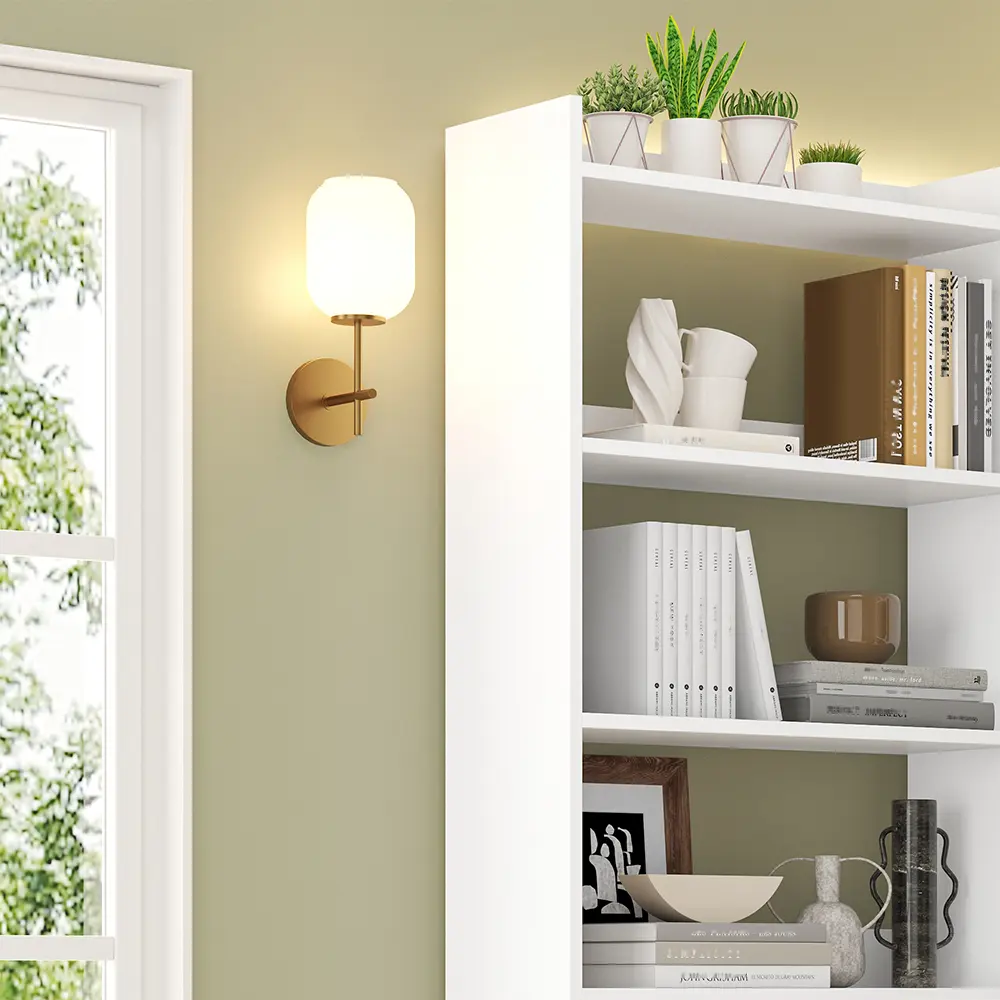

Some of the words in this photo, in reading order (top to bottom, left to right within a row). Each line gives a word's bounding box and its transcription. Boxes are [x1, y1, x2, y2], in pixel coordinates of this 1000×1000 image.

[929, 338, 934, 347] is
[929, 350, 934, 361] in
[929, 424, 934, 437] we
